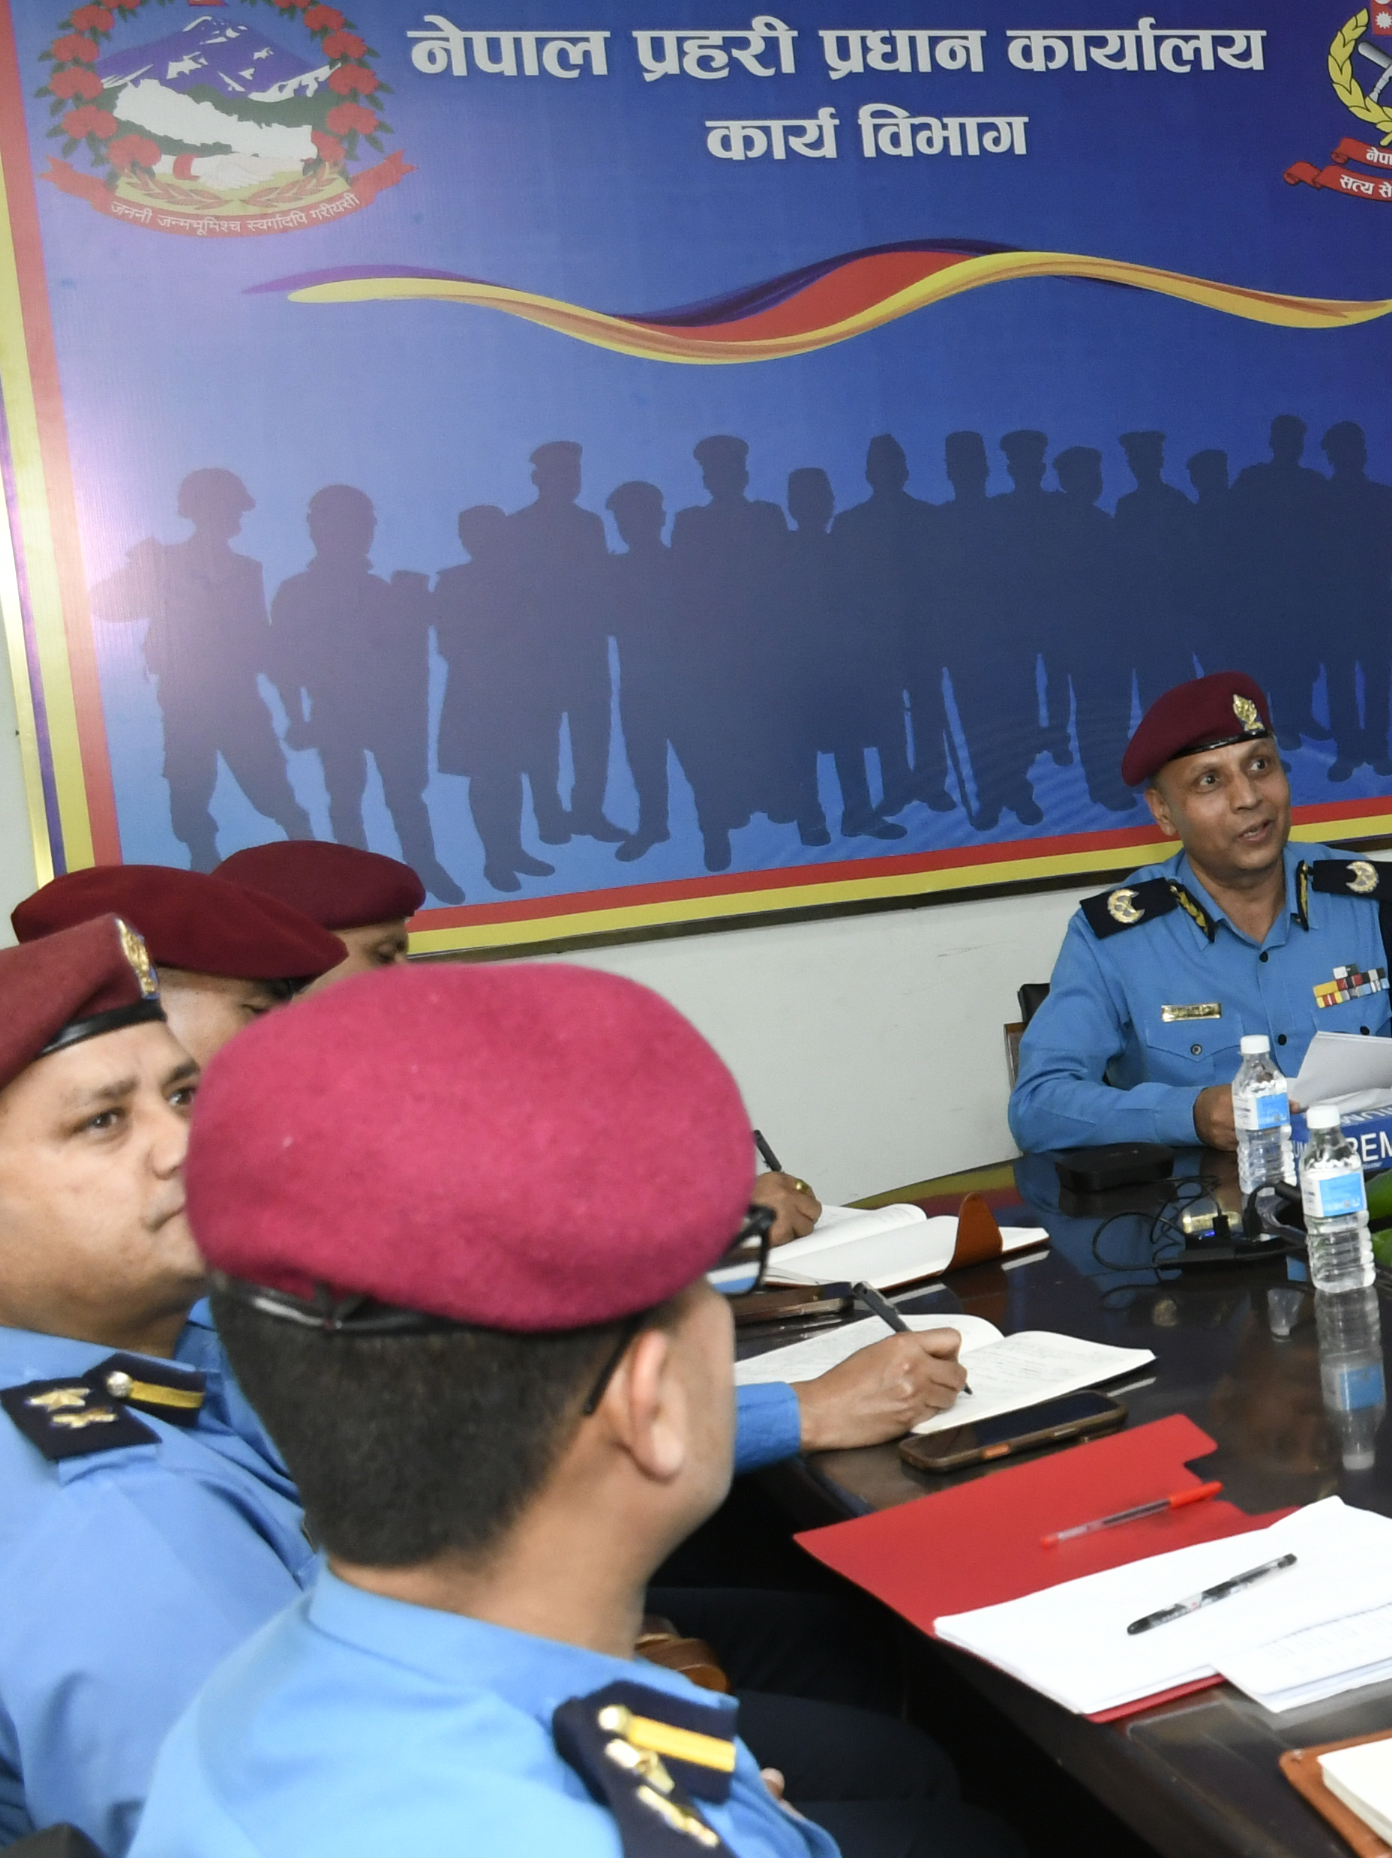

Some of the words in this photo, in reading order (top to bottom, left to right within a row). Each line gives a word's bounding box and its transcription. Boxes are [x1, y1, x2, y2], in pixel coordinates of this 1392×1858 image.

[406, 14, 611, 79] नेपाल
[631, 15, 799, 83] प्रहरी
[818, 29, 987, 80] प्रधान
[1005, 16, 1267, 73] कार्यालय
[704, 106, 840, 161] कार्य
[857, 102, 1029, 158] विभाग
[1339, 174, 1375, 195] सत्य
[110, 200, 153, 224] जननी
[157, 214, 241, 236] जन्मभूमिश्च
[246, 210, 308, 232] स्वर्गादपि
[309, 193, 361, 221] गरीयसी
